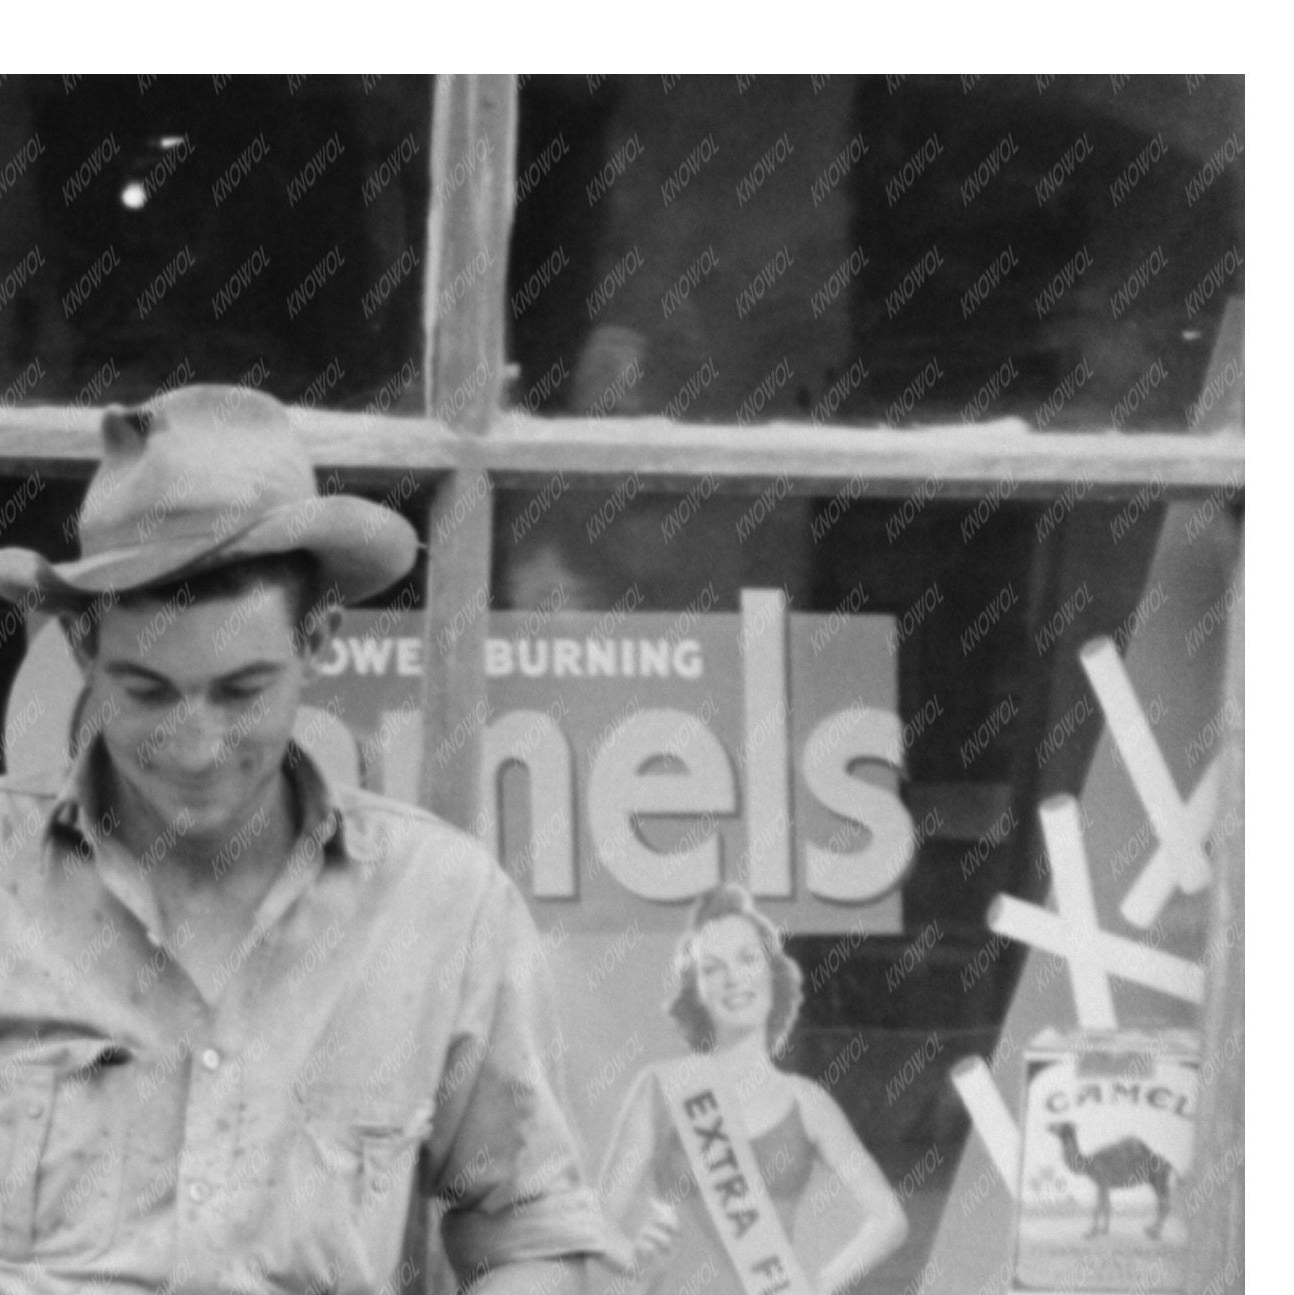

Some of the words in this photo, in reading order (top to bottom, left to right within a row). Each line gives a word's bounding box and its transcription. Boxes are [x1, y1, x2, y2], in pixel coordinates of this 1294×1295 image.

[317, 637, 423, 678] OWE
[484, 637, 704, 678] BURNING
[682, 1089, 760, 1241] EXTRA
